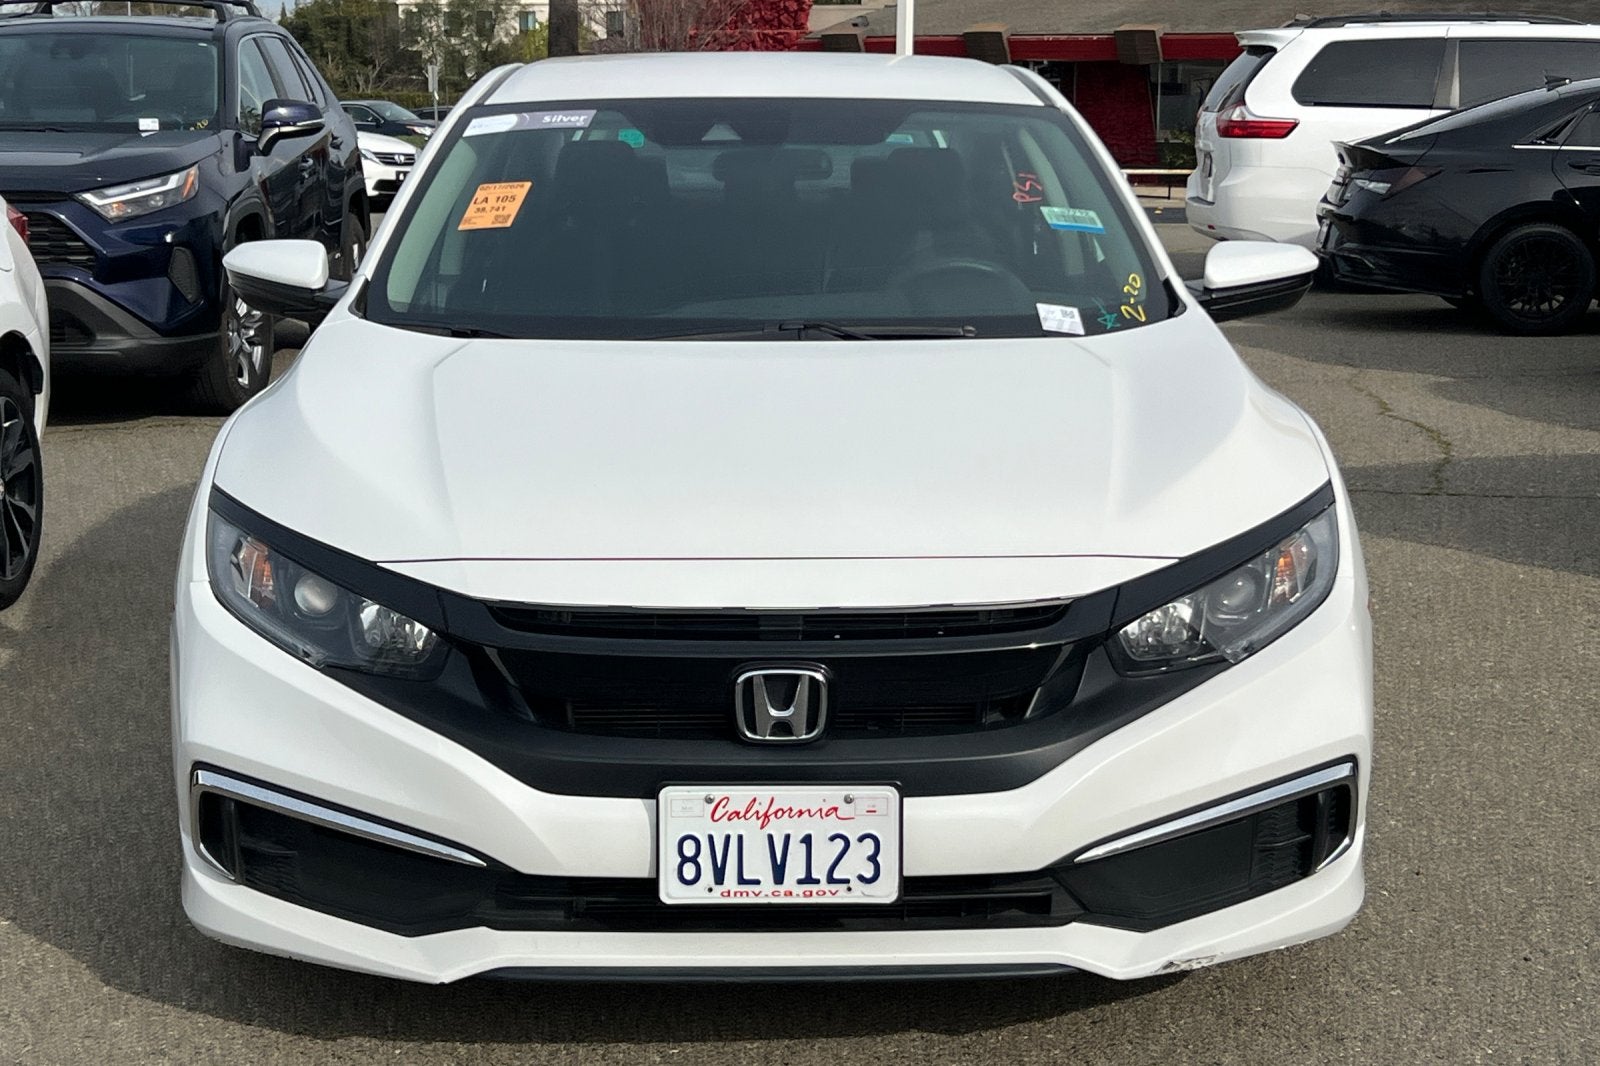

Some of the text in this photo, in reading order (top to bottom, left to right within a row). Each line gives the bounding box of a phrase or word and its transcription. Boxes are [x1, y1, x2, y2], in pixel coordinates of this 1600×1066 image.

[473, 194, 516, 205] LA 105
[710, 796, 855, 830] California
[676, 832, 881, 886] 8VLV123
[719, 888, 840, 898] dmv.ca.gov
